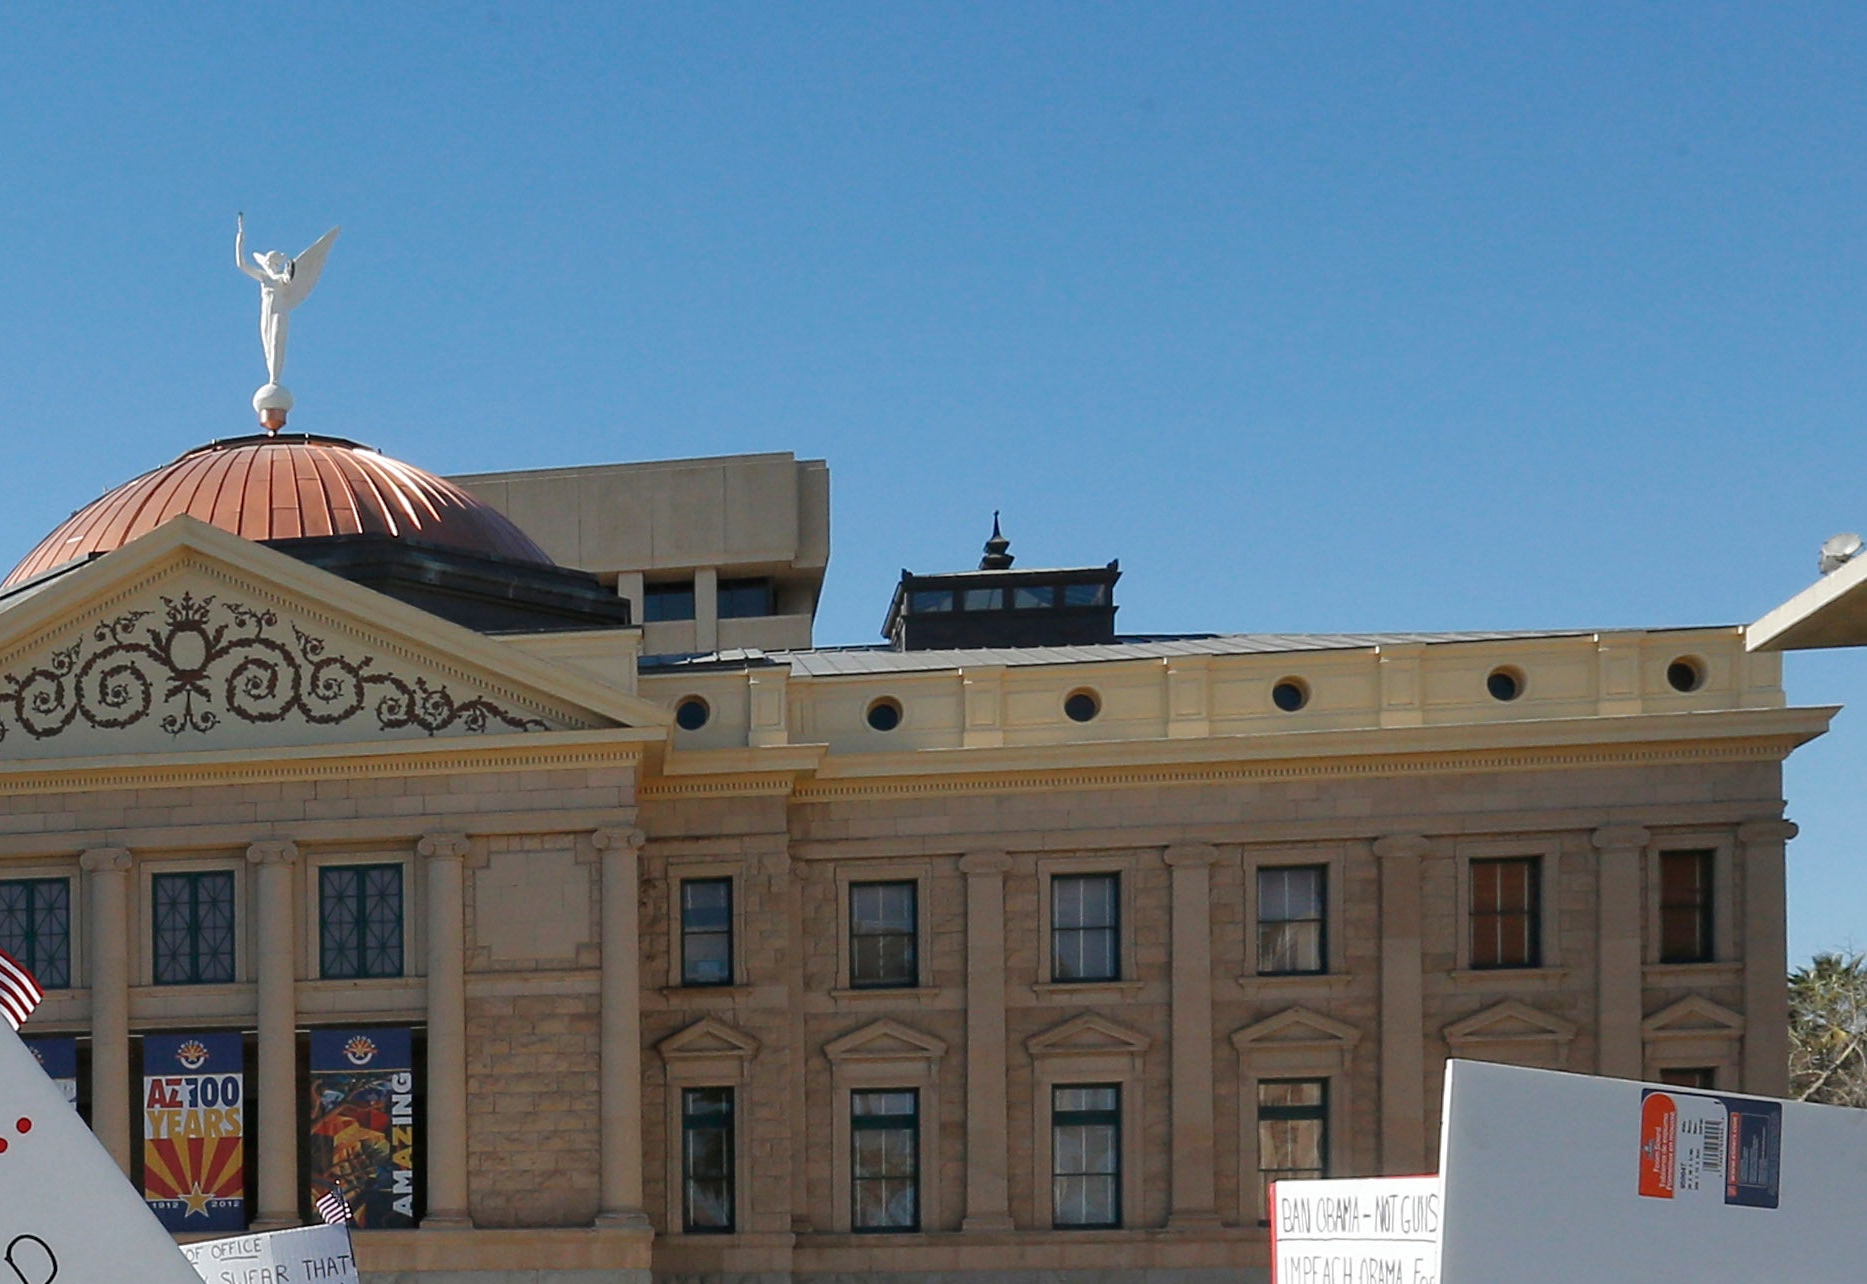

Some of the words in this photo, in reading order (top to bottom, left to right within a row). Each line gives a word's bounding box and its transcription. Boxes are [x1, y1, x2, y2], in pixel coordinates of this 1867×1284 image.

[145, 1106, 242, 1139] YEARS
[391, 1071, 414, 1218] AMAZING
[152, 1201, 180, 1210] 1912
[211, 1199, 241, 1209] 2012
[1281, 1197, 1311, 1234] BAN
[1315, 1195, 1360, 1234] OBAMA
[1374, 1194, 1399, 1233] NOT
[1400, 1193, 1439, 1234] GUNS
[210, 1237, 263, 1260] OFFICE
[301, 1254, 351, 1281] THAT
